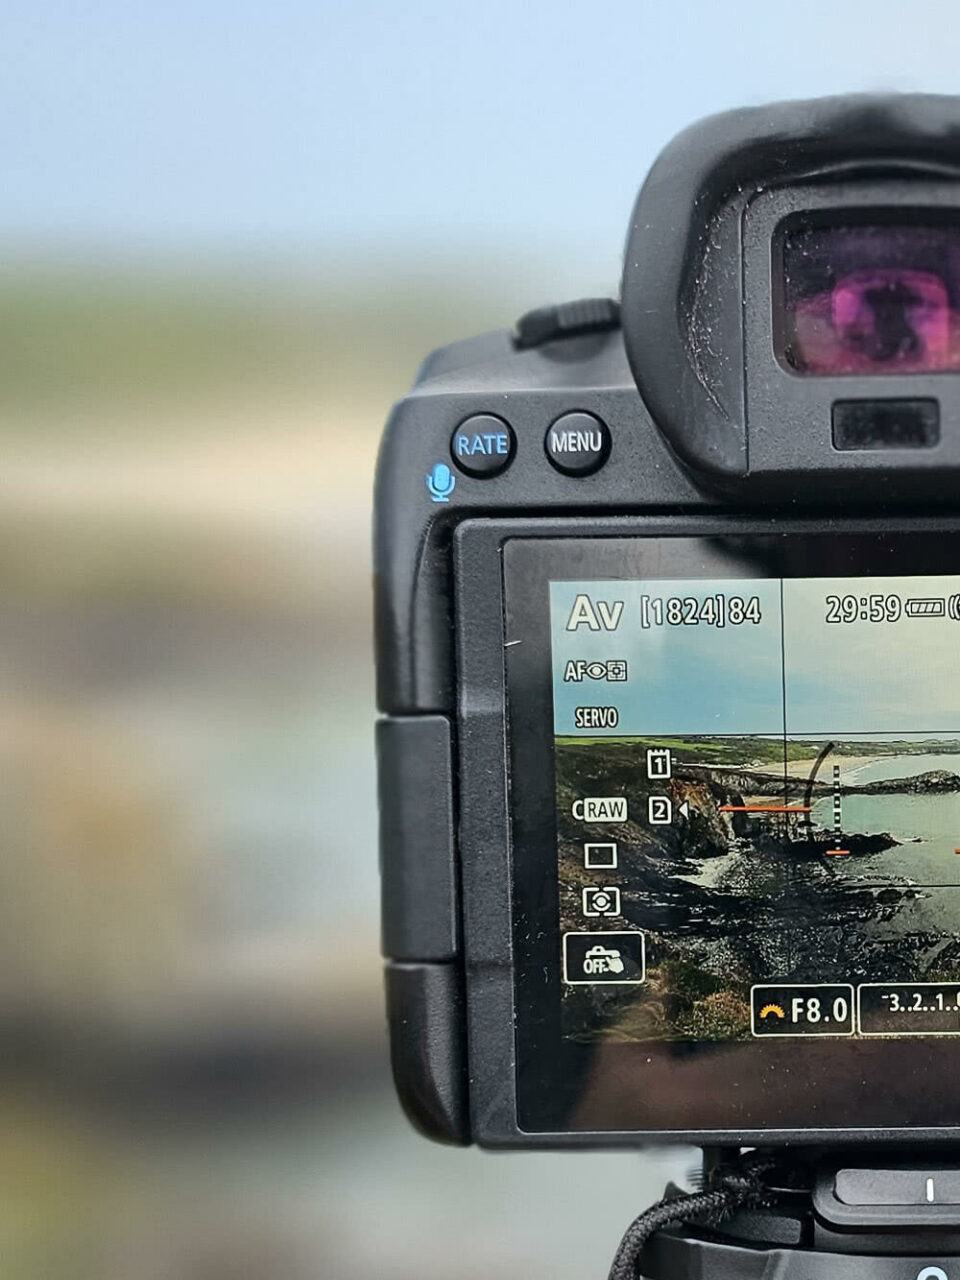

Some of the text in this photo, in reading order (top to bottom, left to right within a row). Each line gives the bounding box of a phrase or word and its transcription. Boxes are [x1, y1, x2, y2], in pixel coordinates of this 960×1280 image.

[457, 433, 509, 456] RATE
[551, 430, 603, 453] MENU
[566, 594, 625, 631] Av
[826, 594, 901, 623] 29:59
[575, 706, 619, 728] SERVO
[791, 997, 848, 1024] F8.0
